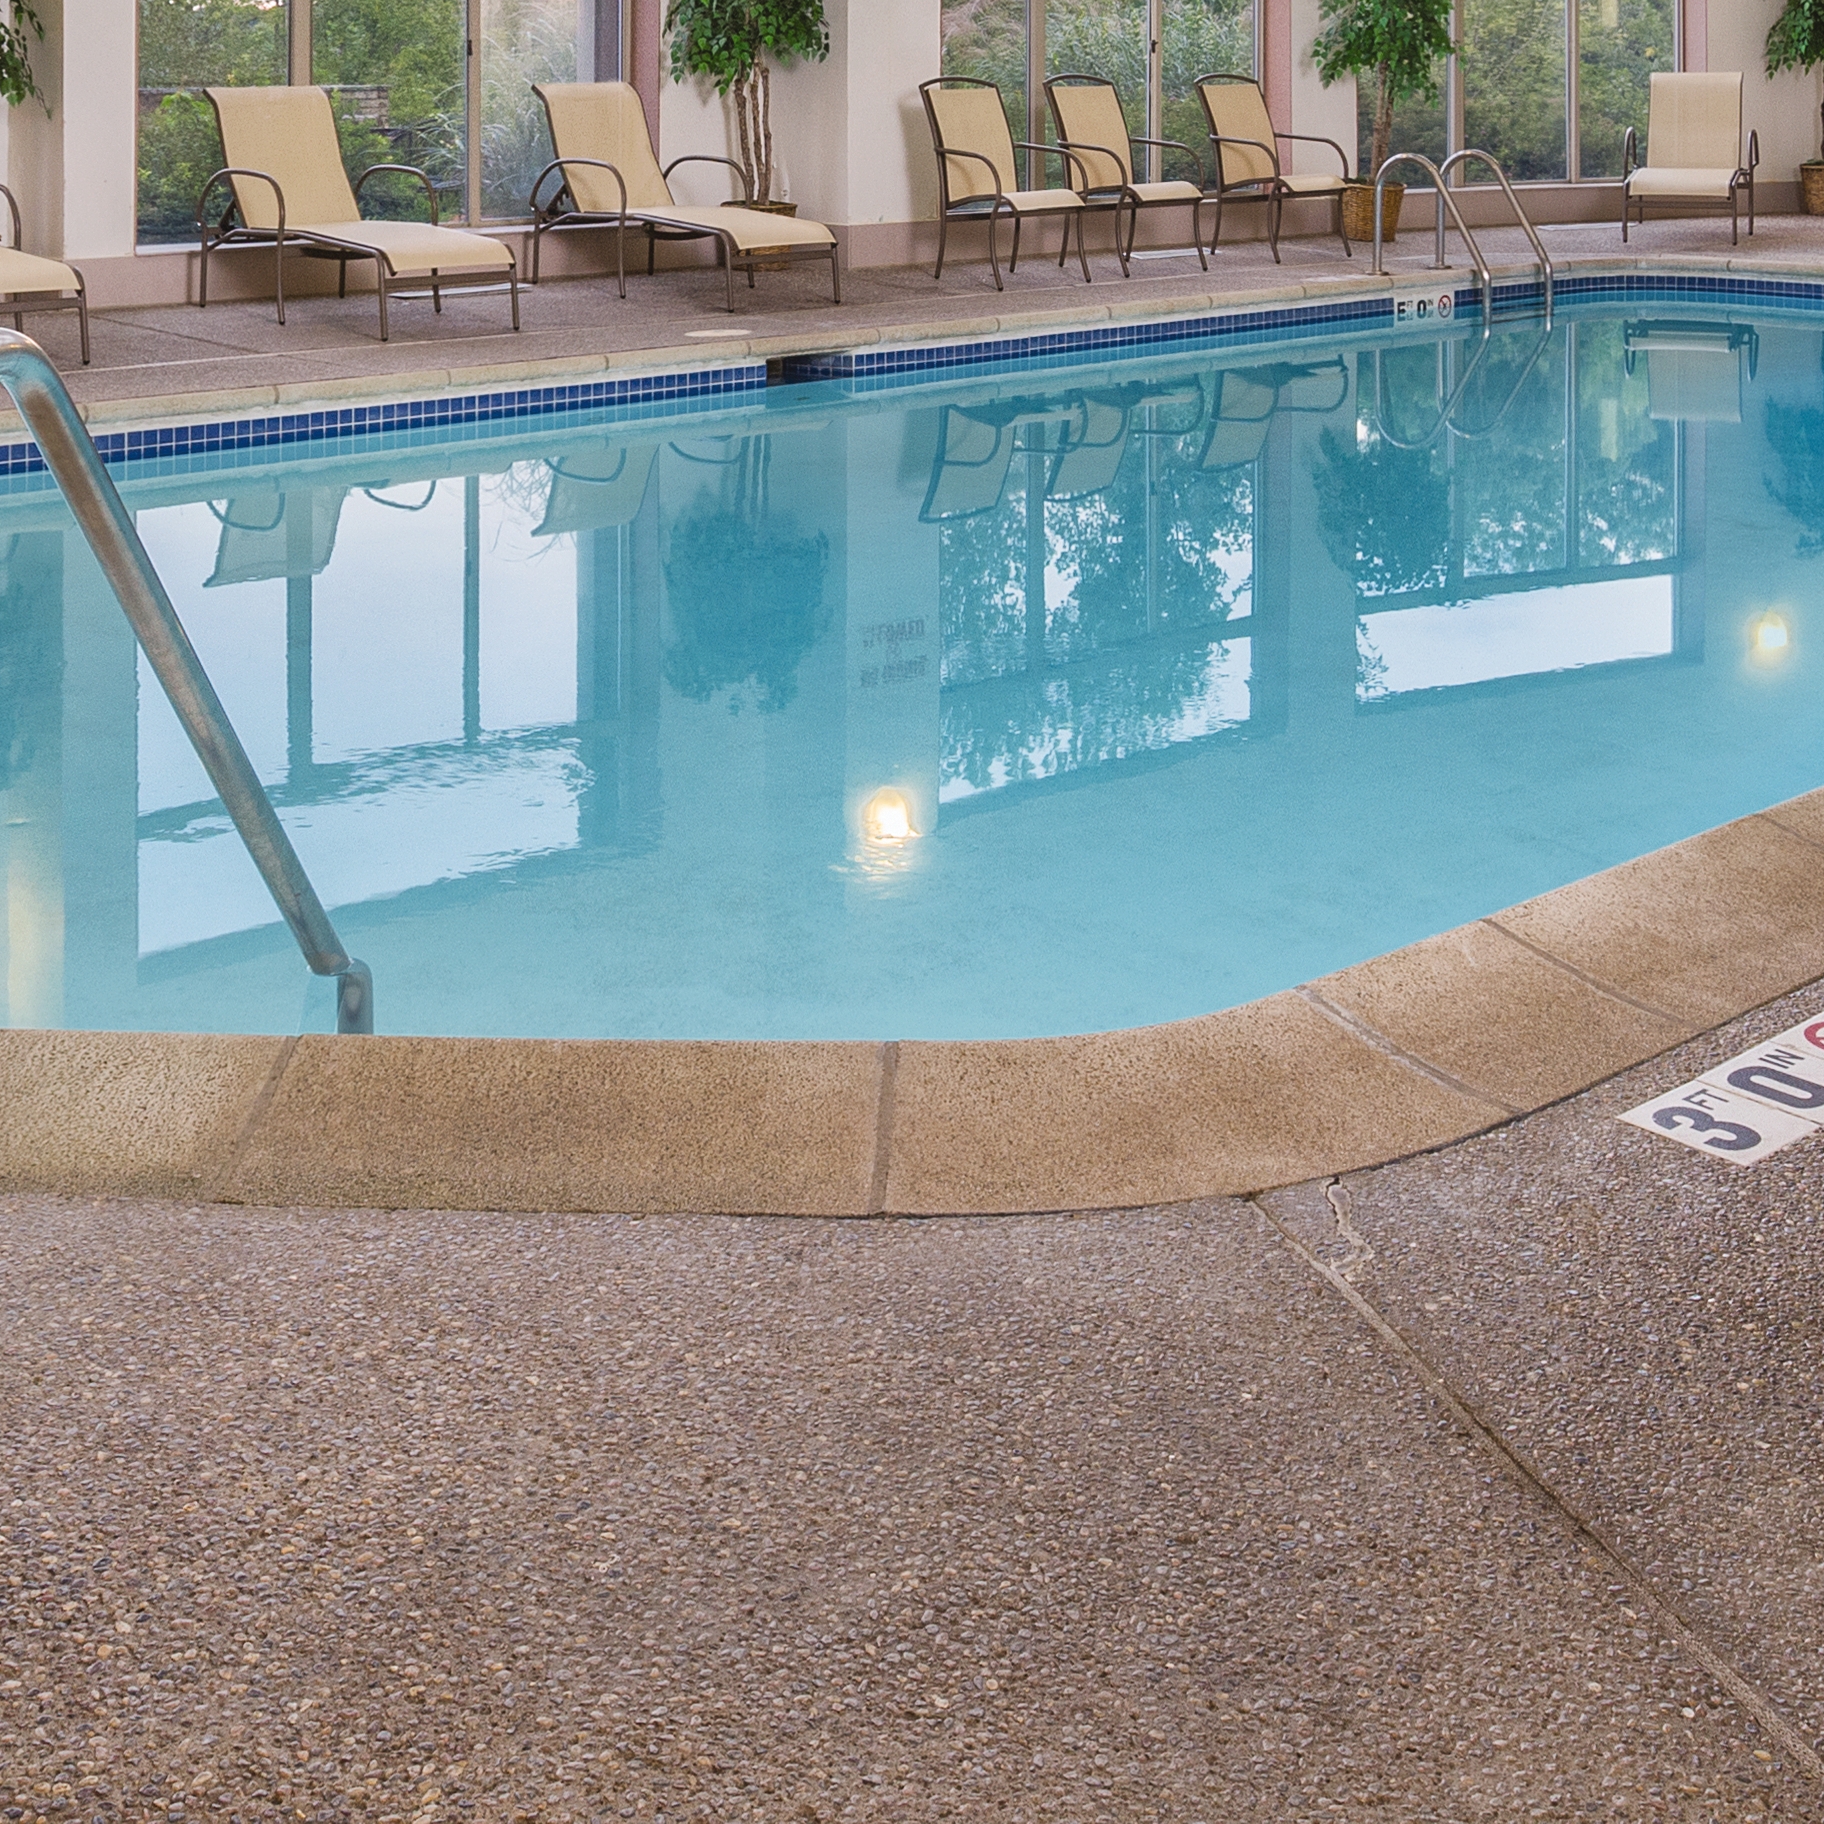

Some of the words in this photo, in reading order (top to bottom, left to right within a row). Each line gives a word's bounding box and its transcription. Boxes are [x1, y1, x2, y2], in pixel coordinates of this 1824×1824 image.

[1762, 1048, 1805, 1069] IN
[1681, 1088, 1730, 1110] FT
[1651, 1106, 1762, 1151] 3
